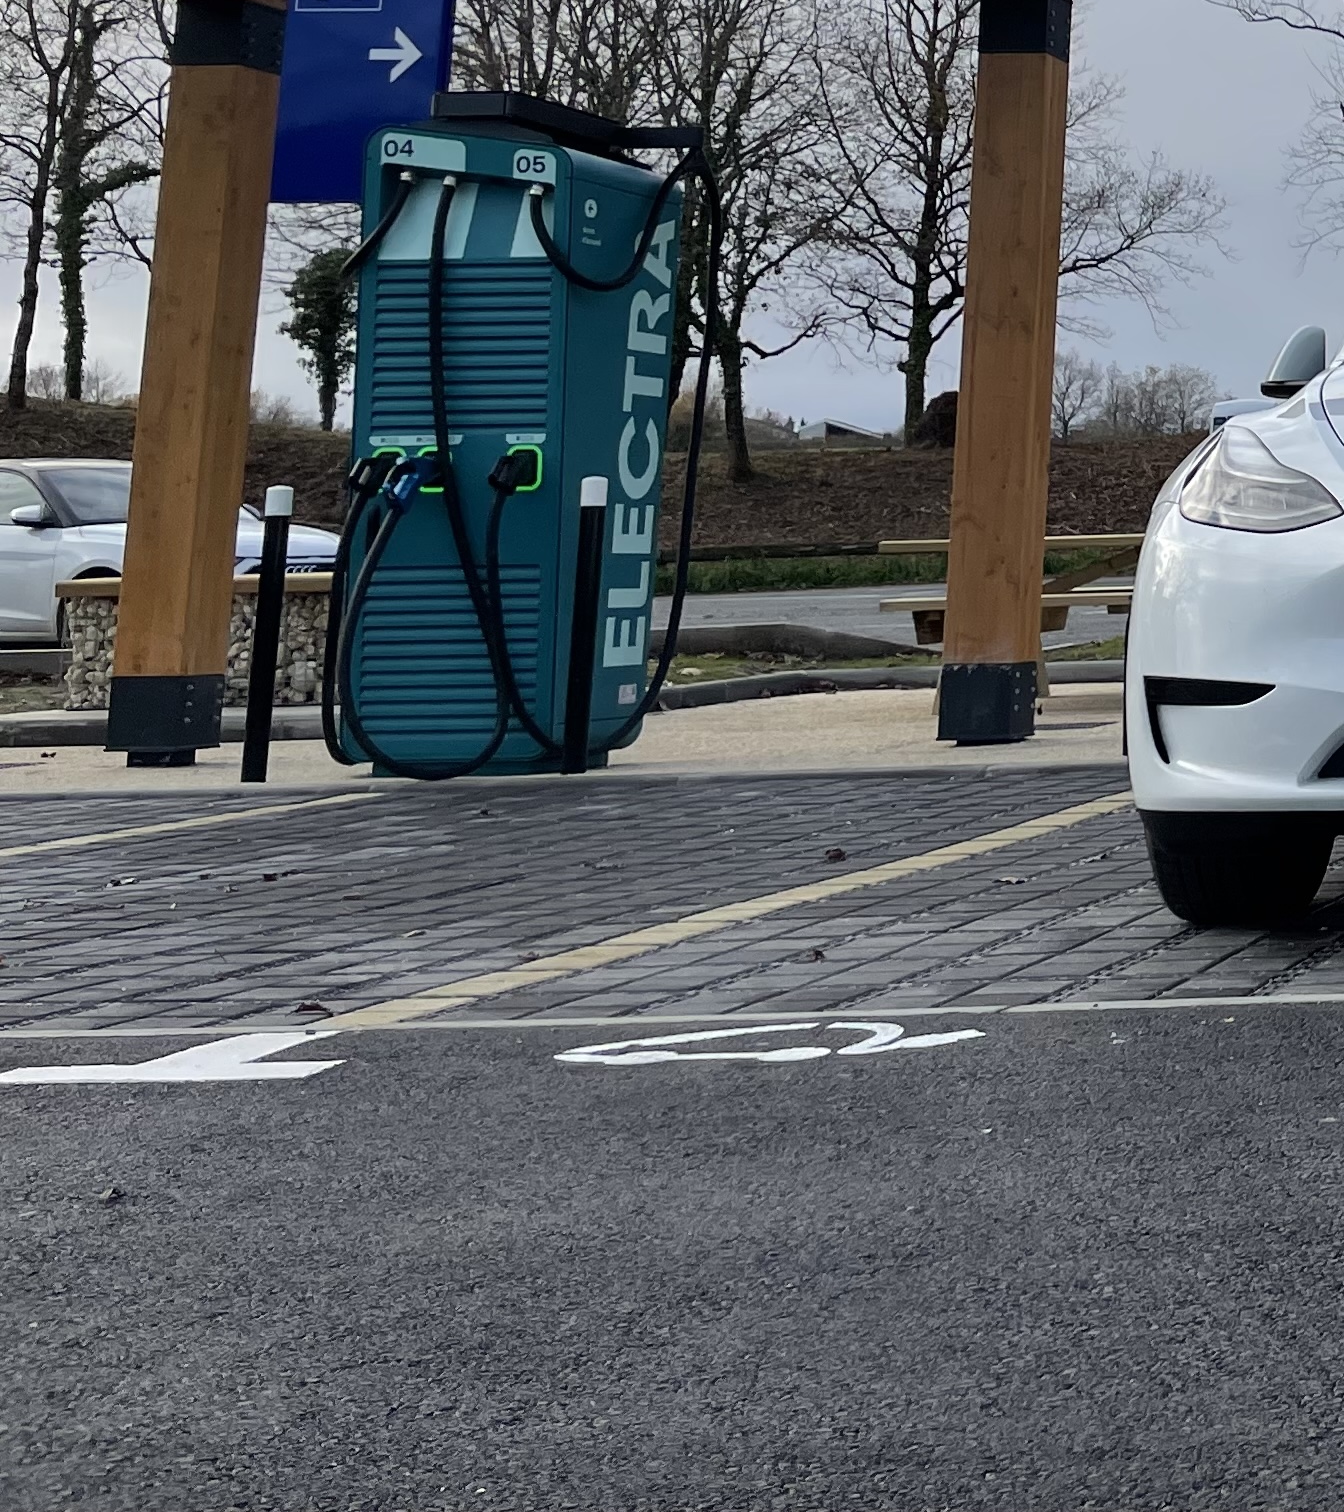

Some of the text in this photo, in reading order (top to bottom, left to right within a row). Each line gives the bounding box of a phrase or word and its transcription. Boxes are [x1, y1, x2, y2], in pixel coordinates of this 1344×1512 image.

[384, 139, 414, 158] 04
[516, 155, 546, 174] 05
[602, 219, 676, 668] ELECTRA
